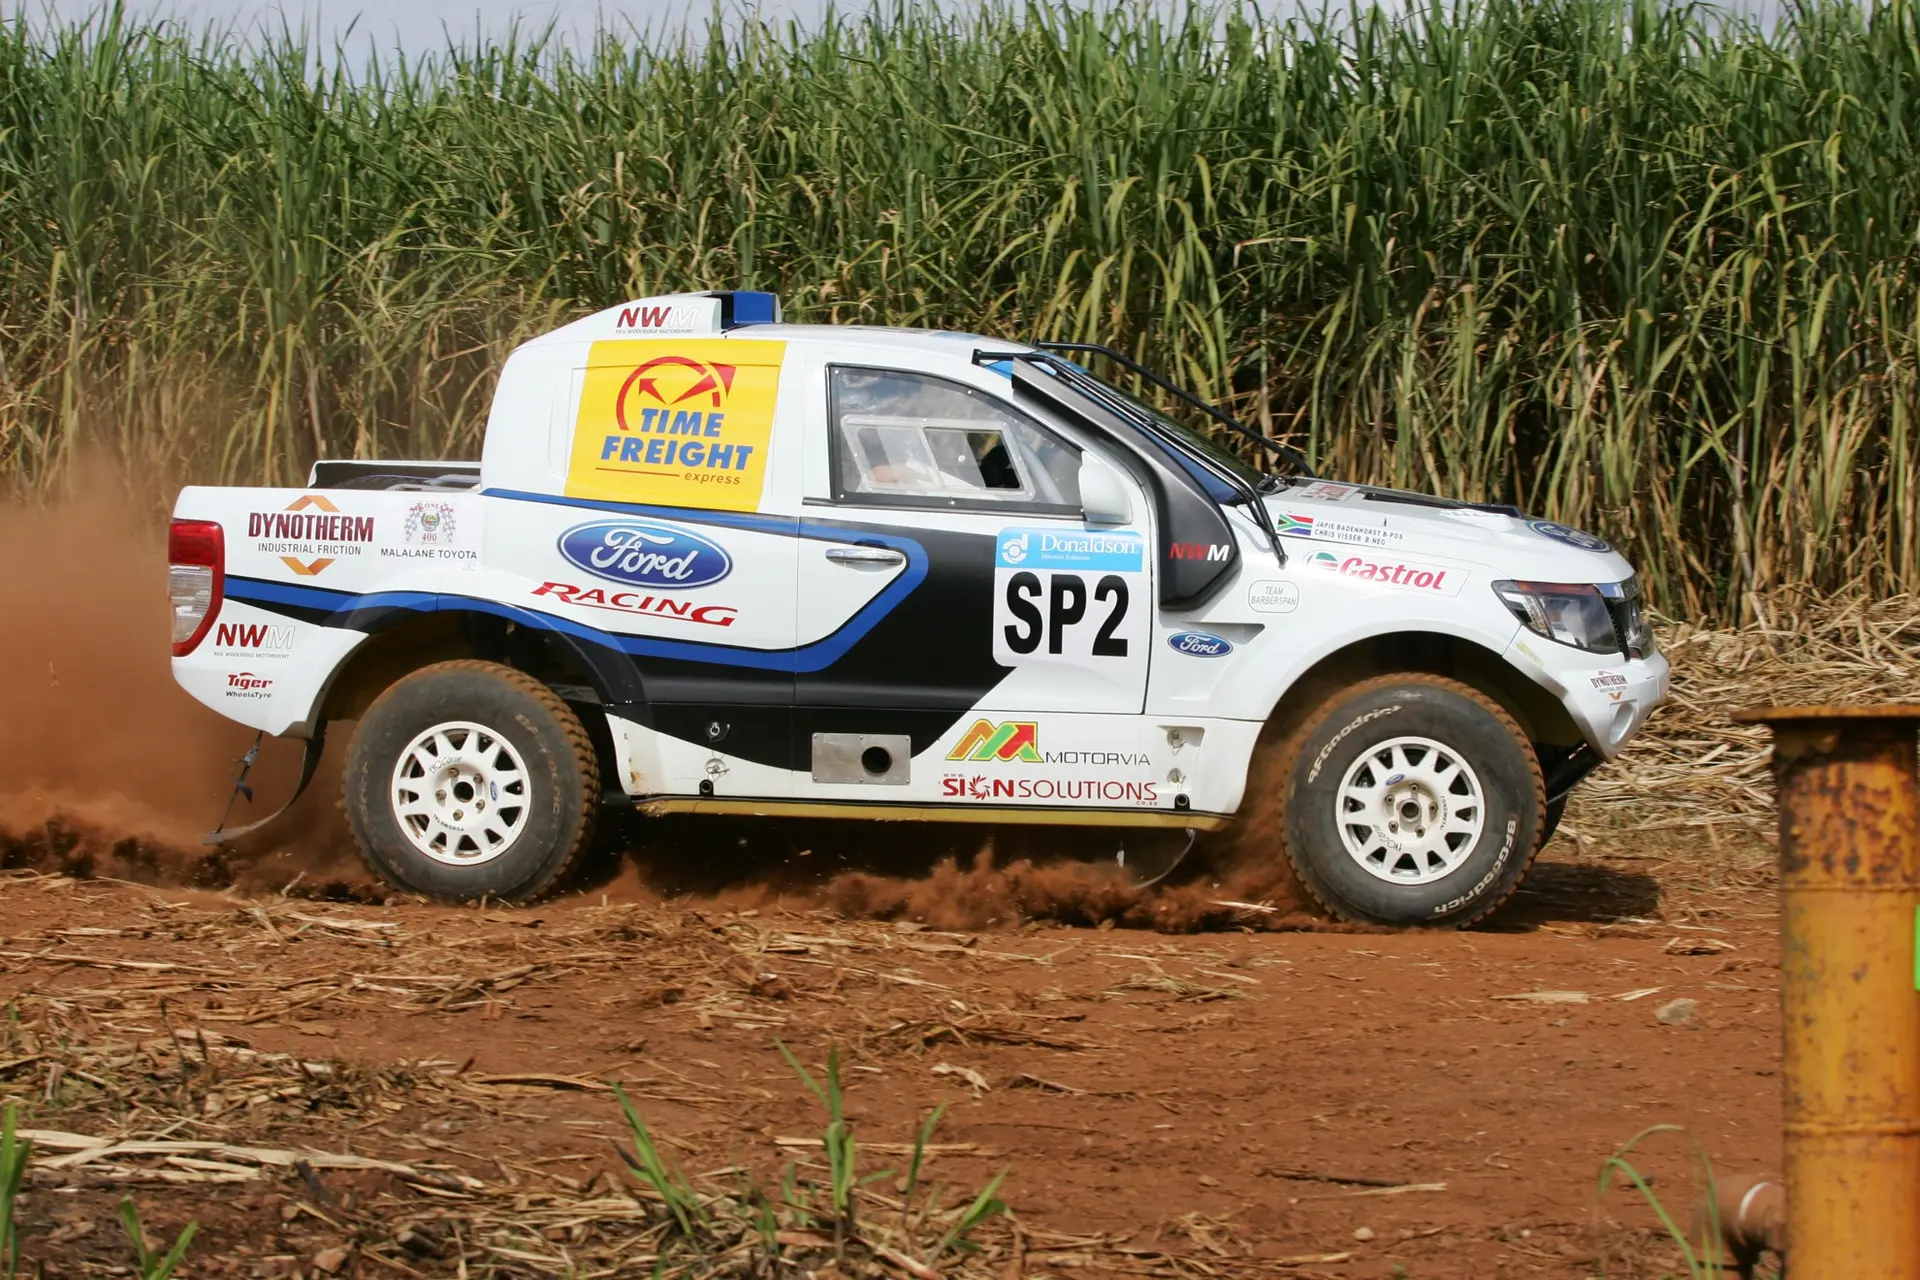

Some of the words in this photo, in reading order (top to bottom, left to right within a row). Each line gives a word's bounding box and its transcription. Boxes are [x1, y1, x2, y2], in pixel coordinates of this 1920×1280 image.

[617, 306, 699, 328] NWM
[641, 408, 724, 437] TIME
[601, 436, 754, 471] FREIGHT
[684, 471, 741, 485] express
[248, 512, 375, 542] DYNOTHERM
[1315, 530, 1335, 538] CHRIS
[1337, 532, 1361, 541] VISSER
[1316, 521, 1335, 530] JAPIE
[1337, 524, 1381, 536] BADENHORST
[258, 543, 314, 554] INDUSTRIAL
[317, 545, 362, 555] FRICTION
[380, 548, 435, 558] MALALANE
[438, 550, 478, 560] TOYOTA
[590, 528, 699, 580] Ford
[1040, 534, 1135, 554] Donaldson
[1168, 542, 1230, 562] NWM
[1340, 557, 1446, 590] Castrol
[1250, 595, 1297, 606] BARBERSPAN
[1265, 586, 1284, 595] TEAM
[531, 581, 738, 627] RACING
[1004, 571, 1129, 657] SP2
[216, 623, 296, 649] NWM
[1179, 634, 1221, 655] Ford
[228, 672, 273, 690] Tiger
[1045, 751, 1151, 766] MOTORVIA
[1433, 819, 1517, 913] BFGoodrich
